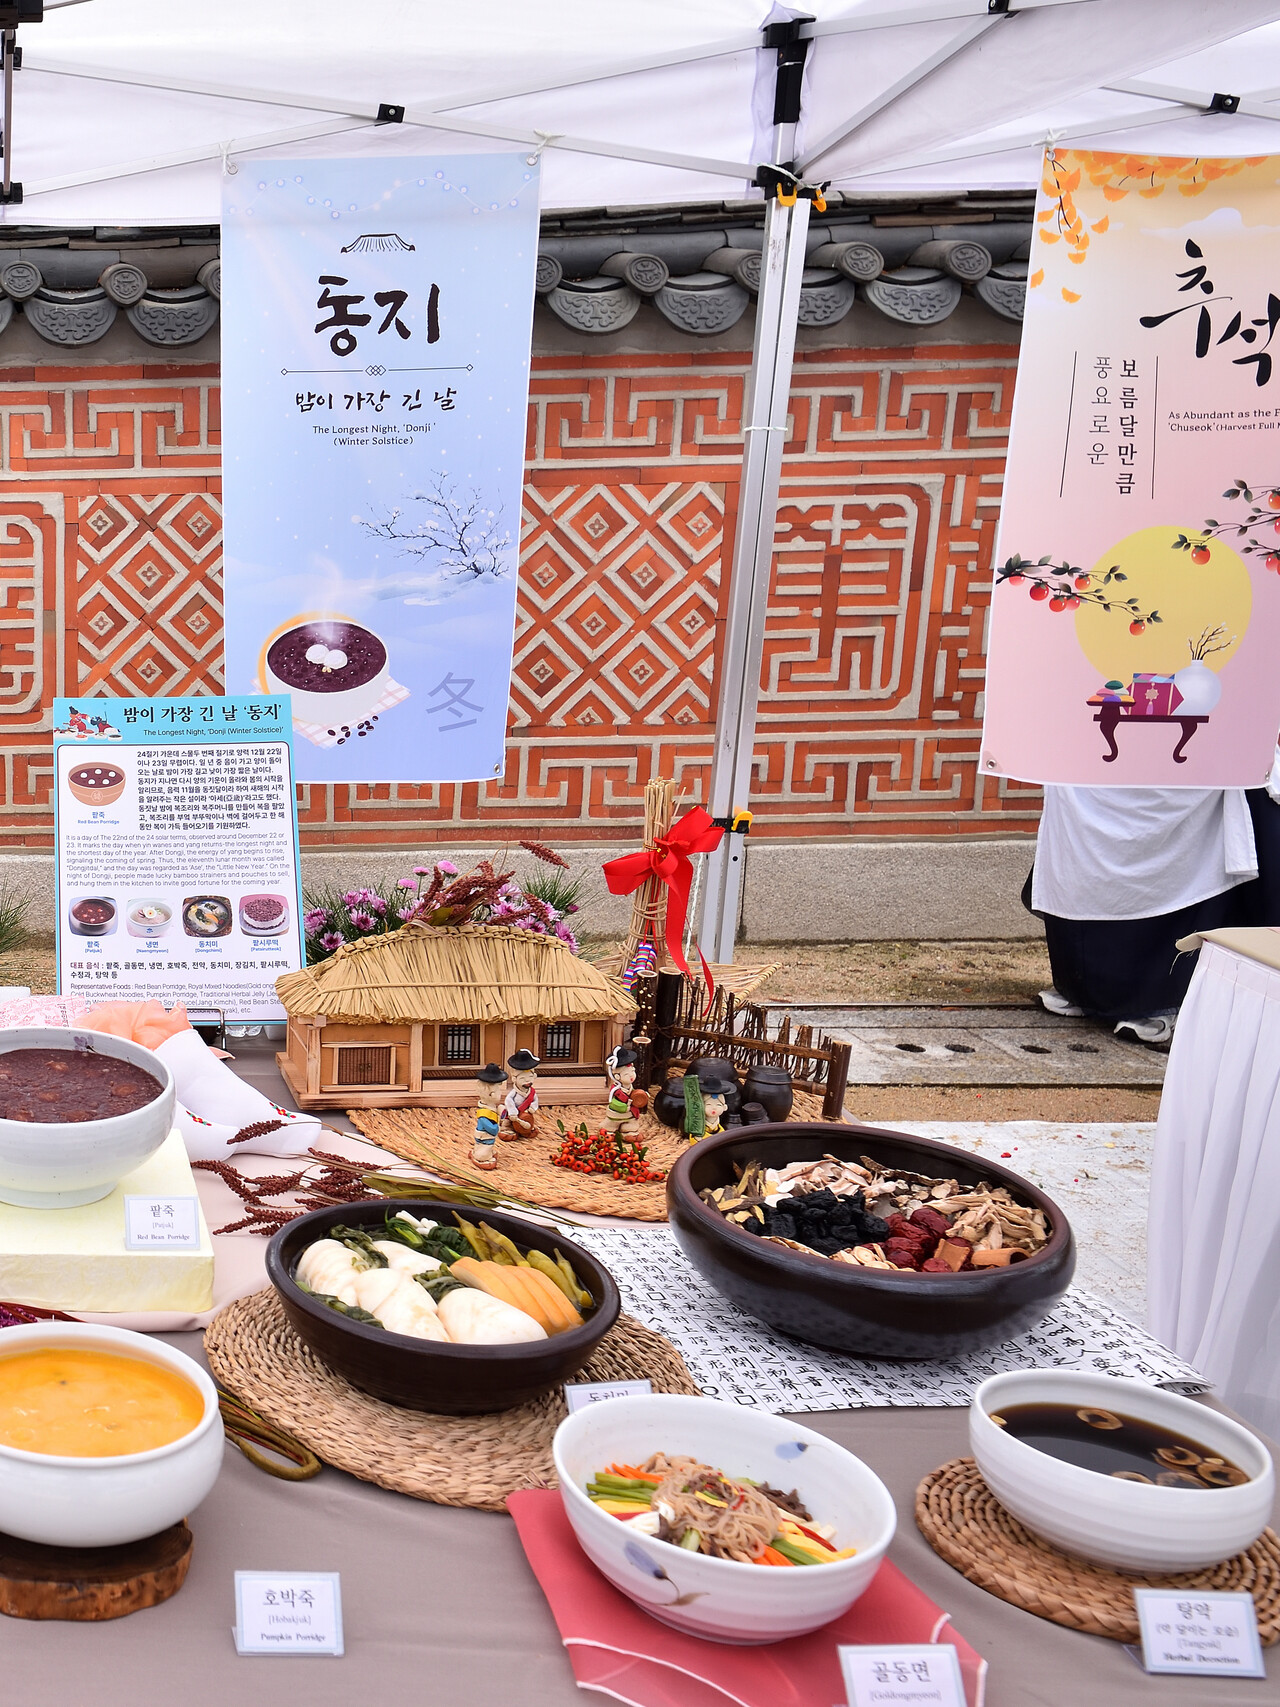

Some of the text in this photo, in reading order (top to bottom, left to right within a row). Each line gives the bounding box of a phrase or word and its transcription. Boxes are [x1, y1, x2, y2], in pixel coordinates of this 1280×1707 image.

[314, 274, 440, 358] 동지
[1139, 238, 1280, 386] 추석
[295, 387, 457, 413] 밤이 가장 긴 날
[1087, 356, 1112, 465] 풍요로운
[1169, 411, 1180, 419] As
[1183, 410, 1234, 420] Abundant
[1237, 410, 1250, 418] as
[1253, 409, 1271, 418] the
[312, 425, 329, 434] The
[331, 425, 368, 435] Longest
[371, 424, 400, 434] Night,
[1115, 359, 1139, 495] 보름달만큼
[333, 436, 414, 446] (Winter Solstice)
[426, 671, 484, 733] 冬
[124, 707, 154, 723] 밤이
[161, 706, 193, 722] 가장
[200, 706, 214, 721] 긴
[222, 705, 237, 721] 날
[186, 728, 205, 736] Night,
[166, 768, 178, 776] 밤이
[224, 767, 236, 775] 가장
[253, 939, 279, 947] 팥시루떡
[70, 962, 84, 970] 대표
[106, 962, 122, 970] 팥죽,
[124, 961, 146, 970] 골동면,
[149, 962, 165, 970] 냉면,
[167, 961, 190, 970] 호박죽,
[192, 961, 208, 970] 전약,
[210, 961, 232, 970] 동치미,
[235, 961, 258, 969] 장김치,
[260, 961, 290, 969] 팥시루떡,
[70, 971, 118, 980] 수정과, 탕약 등
[251, 990, 265, 998] Jelly
[150, 1204, 174, 1218] 팥죽
[262, 1589, 315, 1608] 호박죽
[1177, 1602, 1212, 1620] 탕약
[261, 1633, 326, 1642] Pumpkin Porridge
[872, 1660, 932, 1683] 골동면
